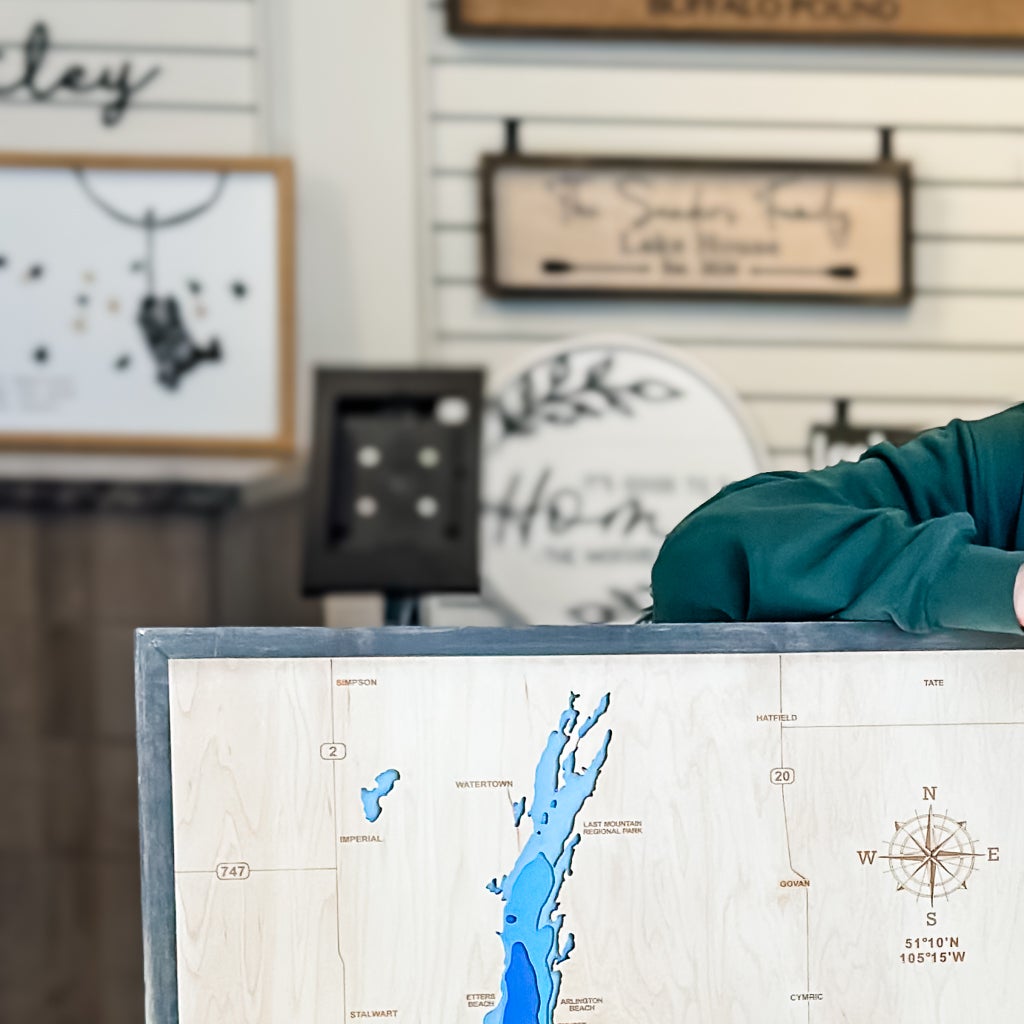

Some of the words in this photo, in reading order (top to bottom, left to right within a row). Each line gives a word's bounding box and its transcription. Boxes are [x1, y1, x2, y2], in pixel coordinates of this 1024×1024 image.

[0, 20, 162, 127] ley
[756, 714, 797, 722] HATFIELD
[329, 747, 337, 756] 2
[775, 771, 790, 782] 20
[923, 787, 937, 800] N
[340, 835, 382, 843] IMPERIAL
[857, 851, 877, 865] W
[987, 848, 999, 861] E
[220, 866, 245, 877] 747
[926, 912, 937, 926] S
[350, 1010, 397, 1019] STALWART
